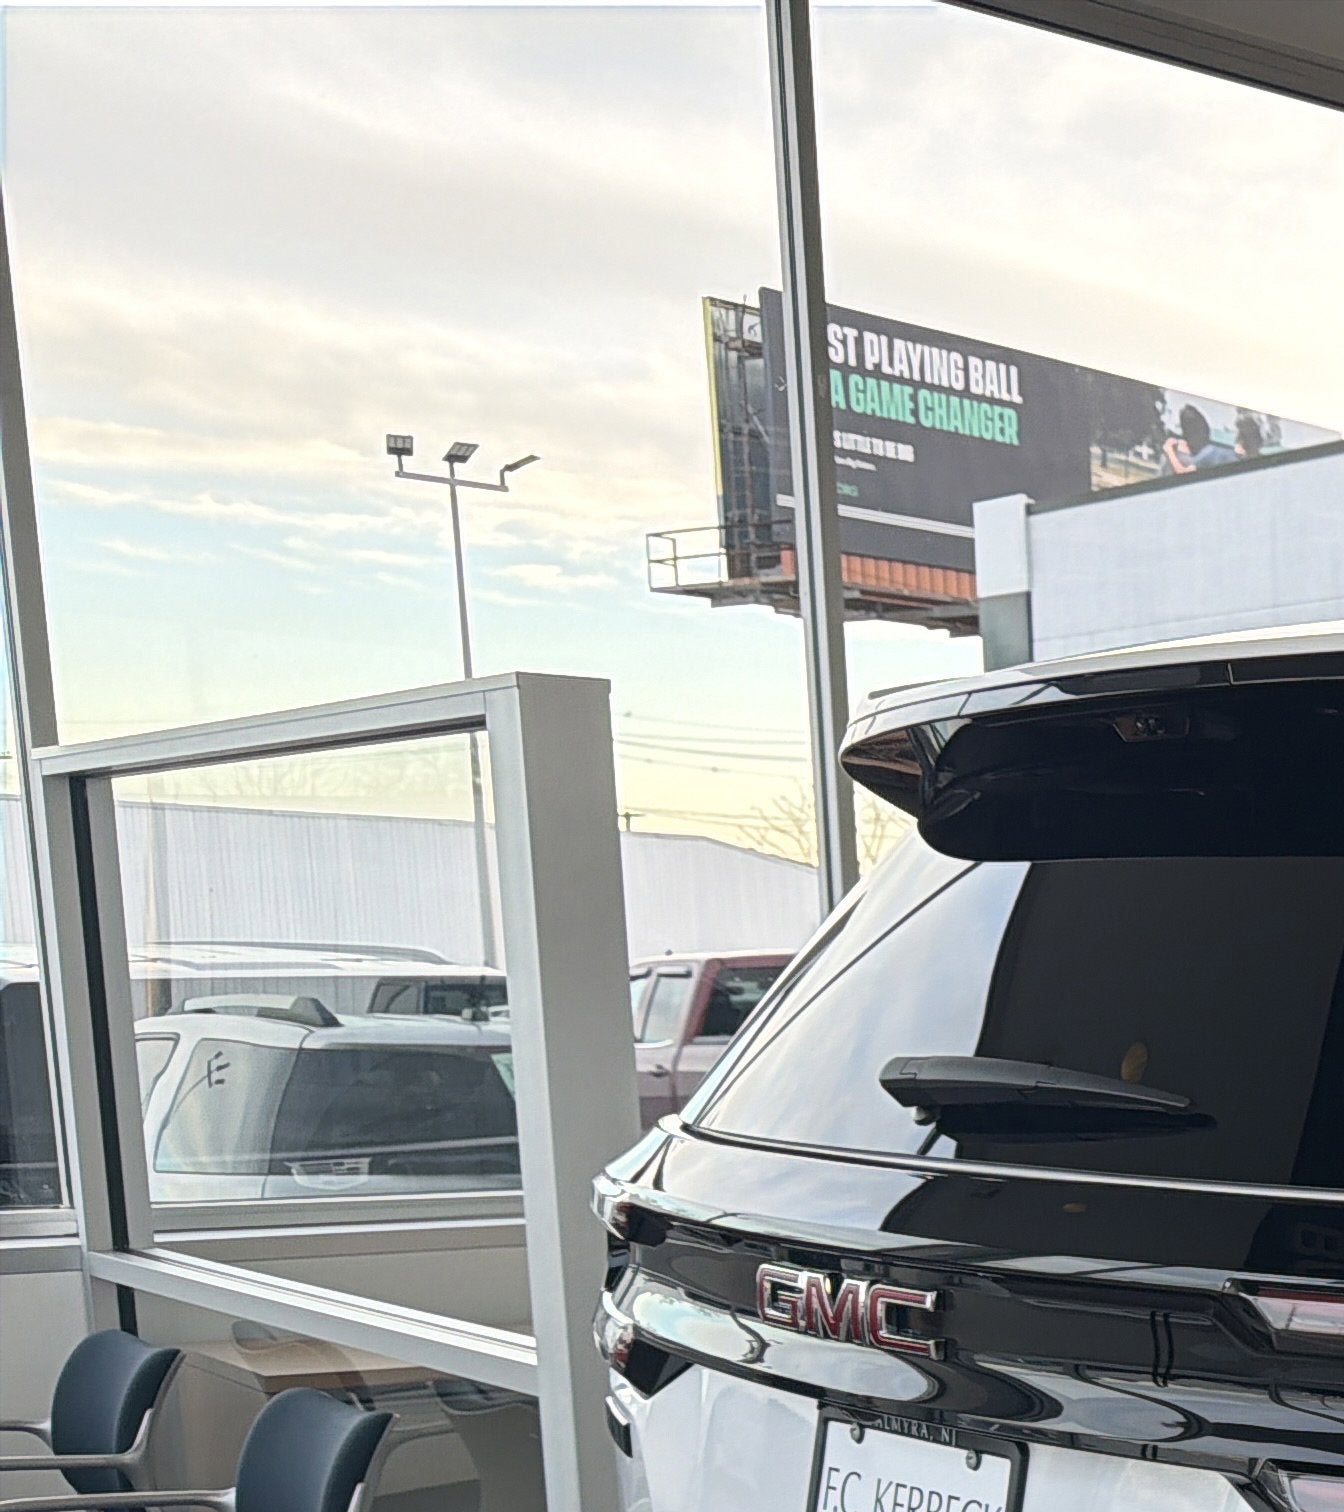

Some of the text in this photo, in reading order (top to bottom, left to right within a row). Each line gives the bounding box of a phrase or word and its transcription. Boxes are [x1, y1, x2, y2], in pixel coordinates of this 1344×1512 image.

[826, 322, 1023, 404] ST PLAYING BALL
[829, 368, 1020, 446] A GAME CHANGER
[756, 1263, 938, 1358] GMC
[873, 1416, 933, 1441] ALMYRA,
